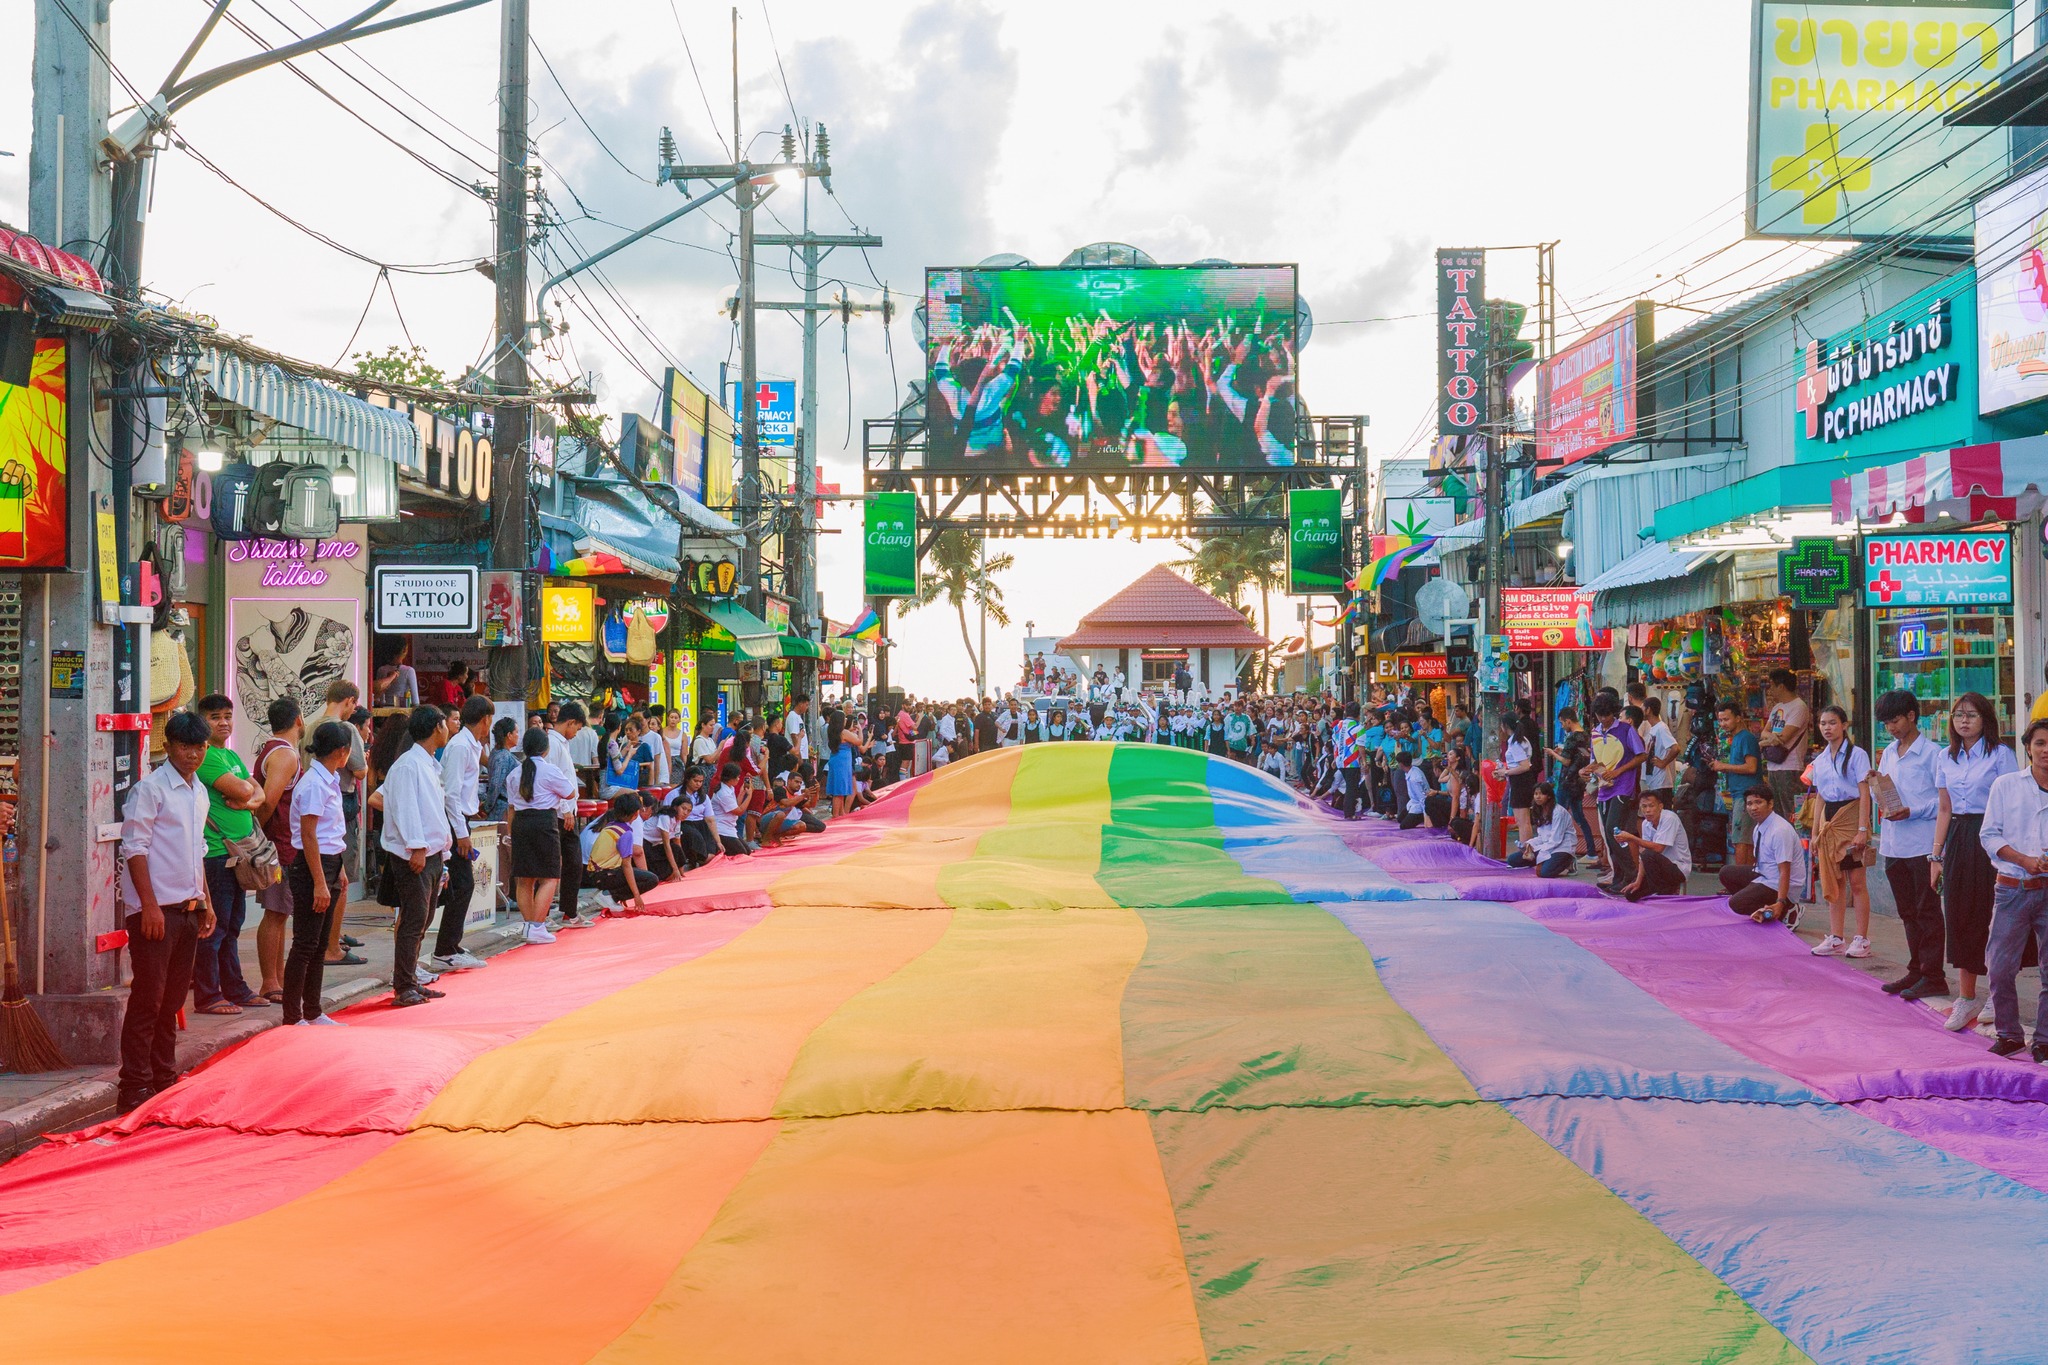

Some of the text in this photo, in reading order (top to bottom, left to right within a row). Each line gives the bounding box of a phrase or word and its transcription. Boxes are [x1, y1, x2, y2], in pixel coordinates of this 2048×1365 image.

[1774, 18, 1998, 70] ขายยา
[1770, 77, 2000, 112] PHARMACY
[1444, 268, 1479, 427] TATTOO
[1824, 363, 1950, 443] PC PHARMACY
[737, 411, 792, 421] PRMACY
[1601, 403, 1610, 425] 199
[868, 531, 912, 548] Chang
[1293, 528, 1338, 545] Chang
[1868, 539, 2006, 565] PHARMACY
[262, 561, 328, 586] tattoo
[1795, 568, 1839, 577] PHARMACY
[1905, 569, 2007, 589] صيدلية
[386, 592, 464, 607] TATTOO
[1521, 594, 1571, 603] COLLECTION
[1945, 591, 2007, 602] Аптека
[1505, 604, 1569, 612] Exclusive
[546, 624, 584, 632] SINGHA
[1545, 633, 1561, 641] 199
[1901, 628, 1924, 652] OPEN
[1418, 668, 1436, 676] BOSS
